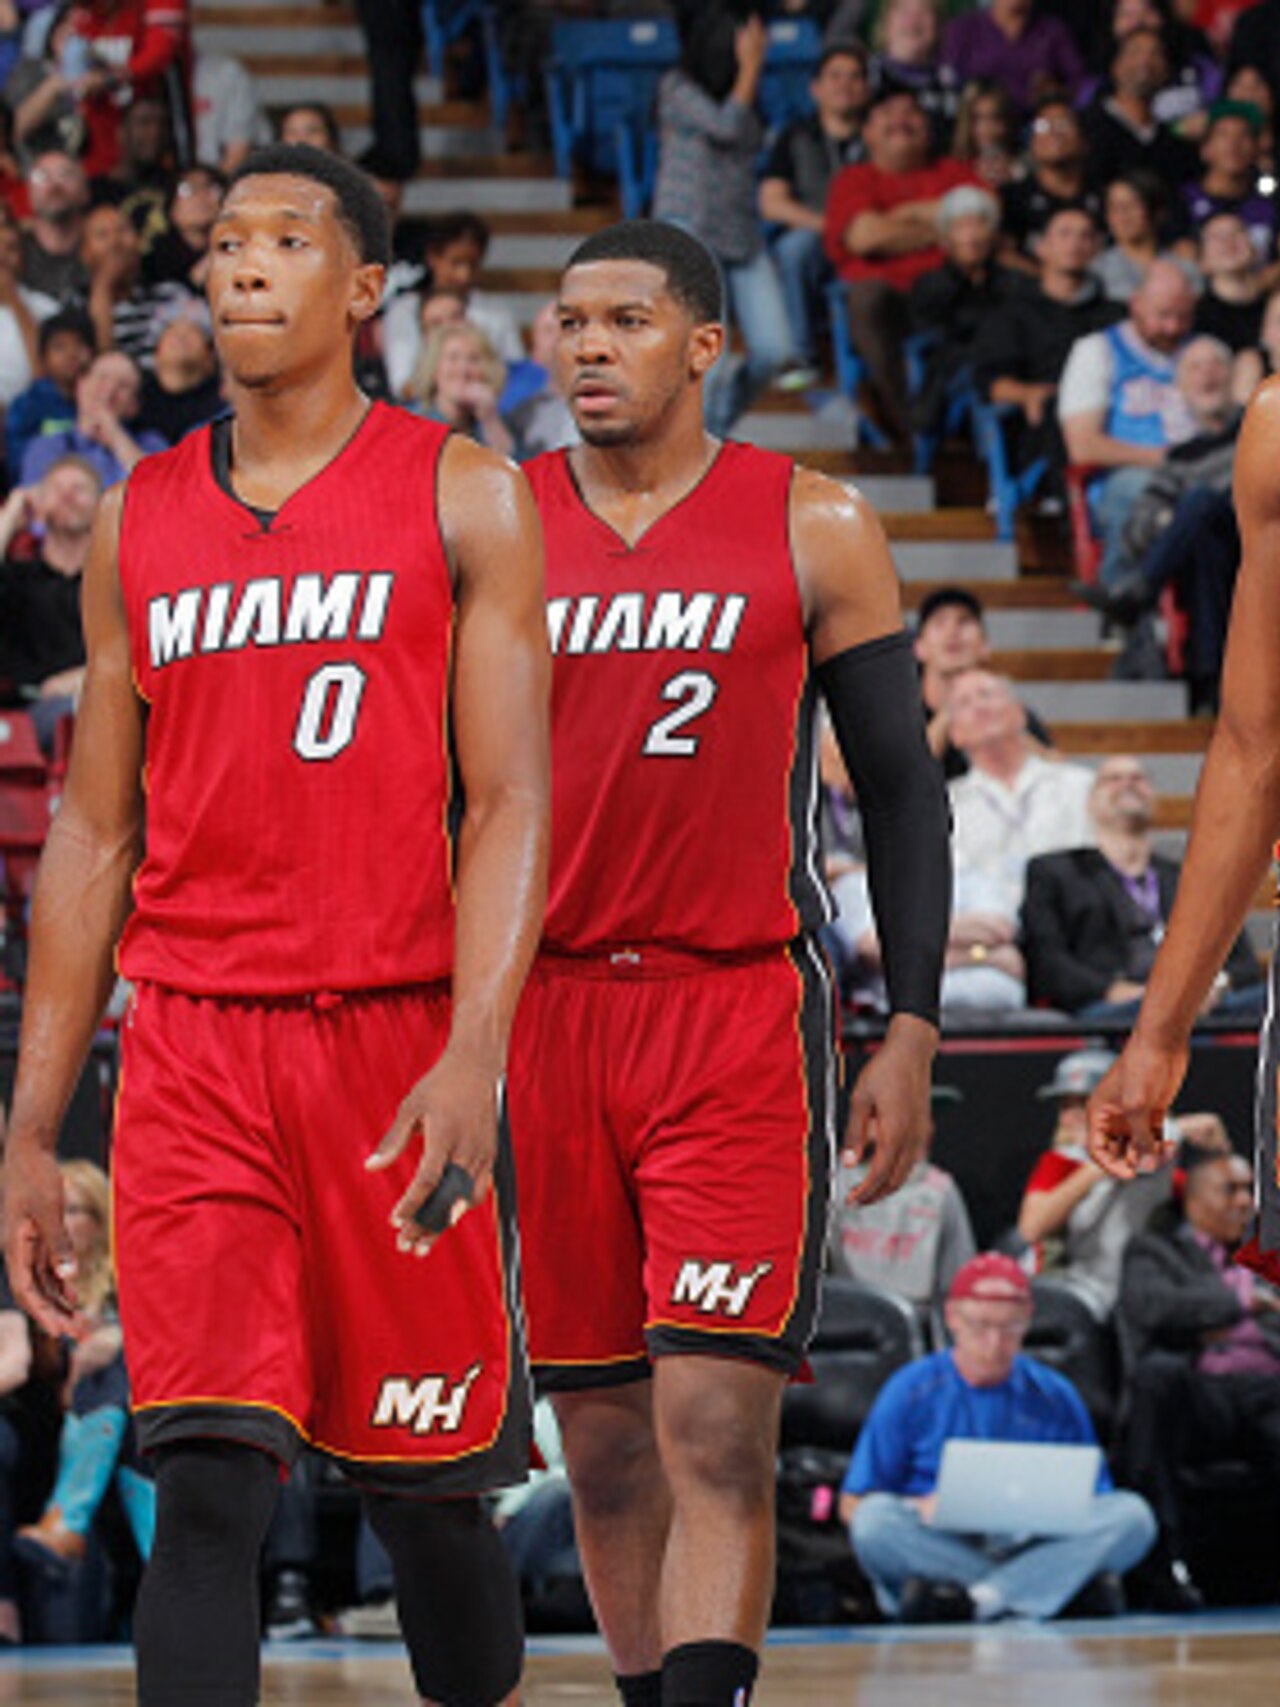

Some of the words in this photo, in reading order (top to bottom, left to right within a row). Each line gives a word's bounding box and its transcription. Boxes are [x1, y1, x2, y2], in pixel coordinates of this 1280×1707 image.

[148, 571, 395, 670] MIAMI
[293, 661, 366, 762] 0
[641, 669, 720, 758] 2
